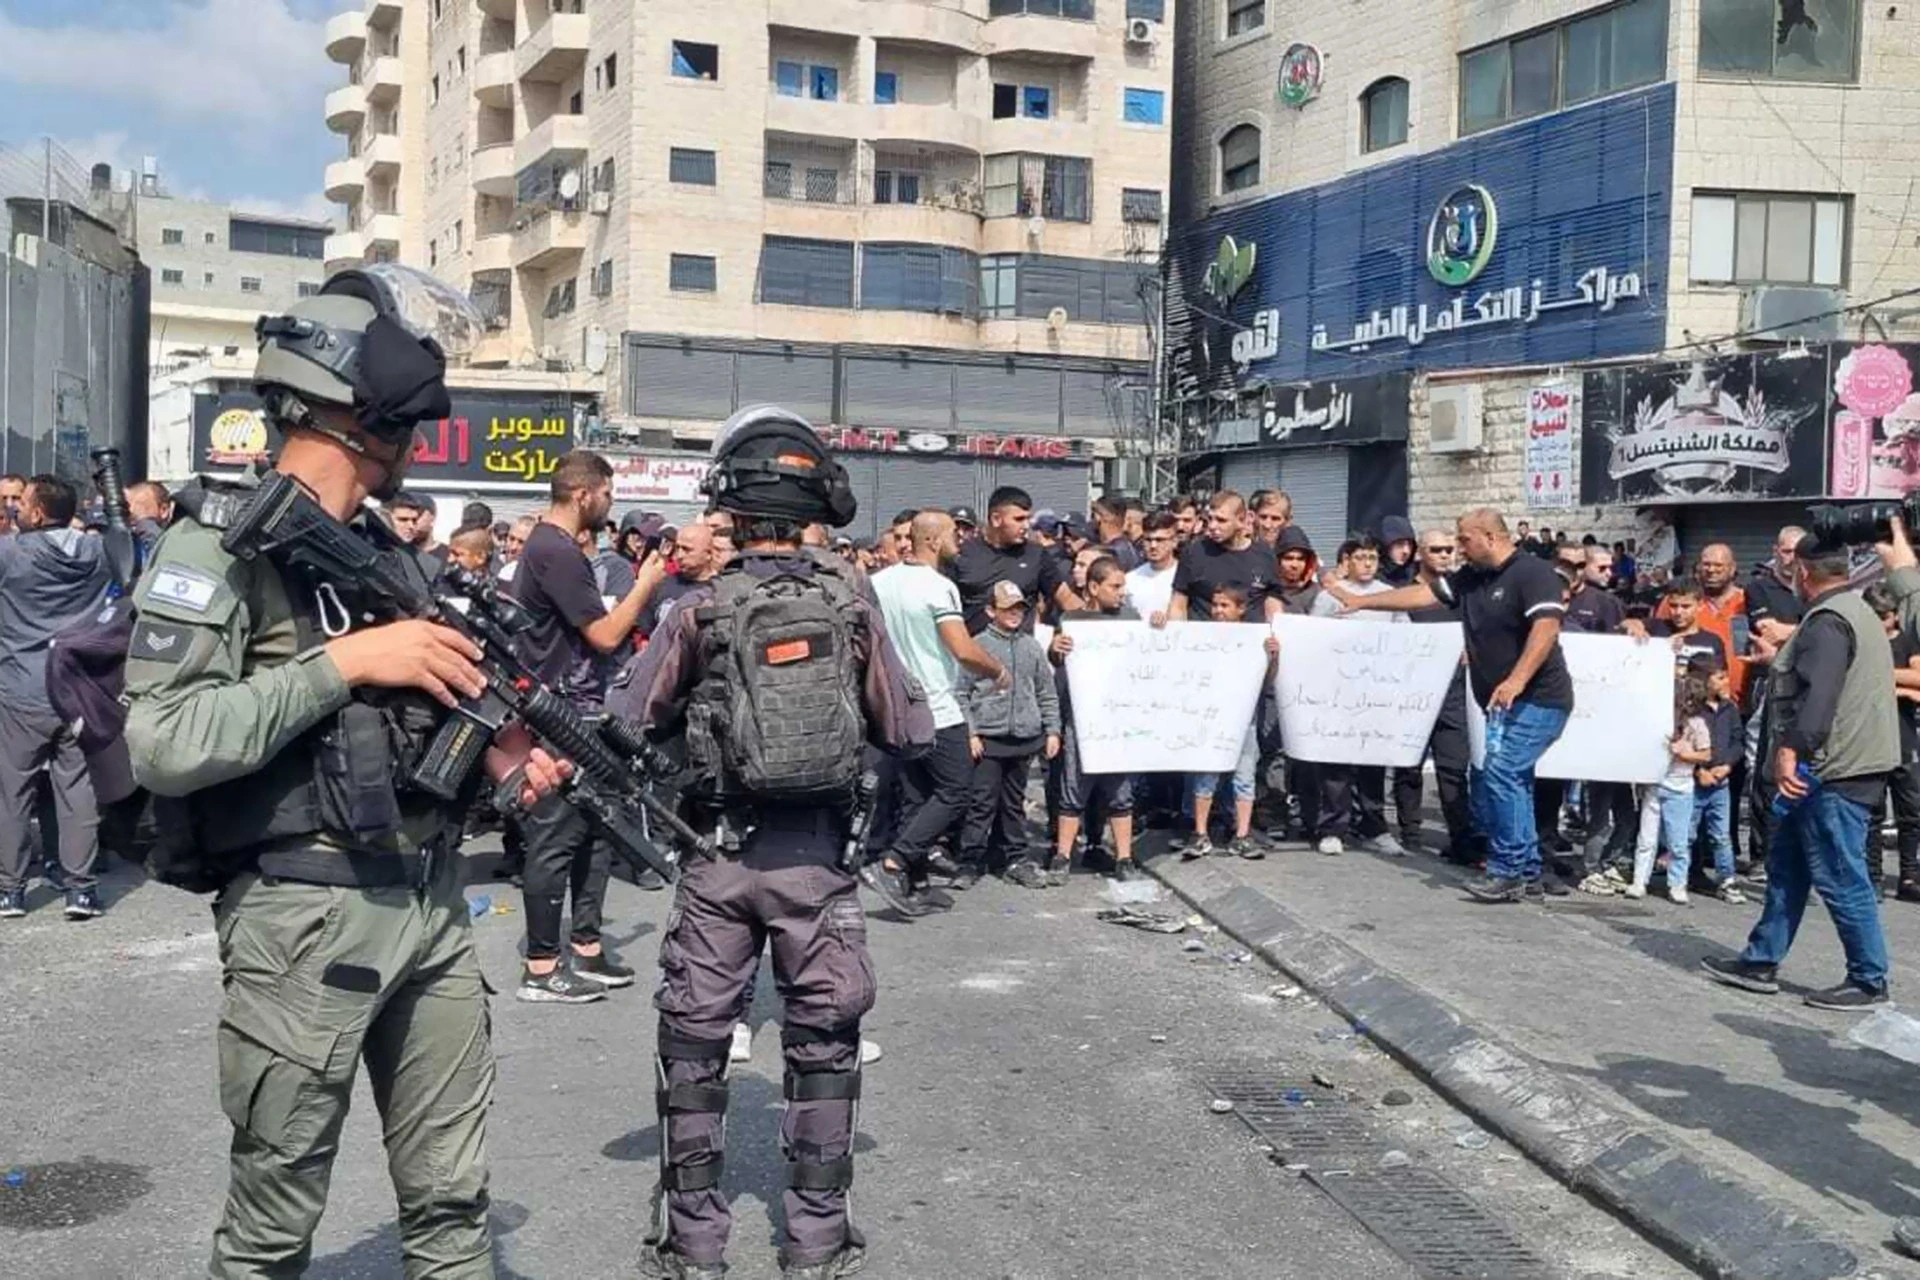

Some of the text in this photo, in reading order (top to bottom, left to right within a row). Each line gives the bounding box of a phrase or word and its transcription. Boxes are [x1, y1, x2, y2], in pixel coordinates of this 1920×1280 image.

[1311, 267, 1640, 352] مراكز التكامل الطبية
[1263, 382, 1351, 441] الأسطورة
[1531, 389, 1569, 412] محلات
[486, 415, 566, 442] سوبر
[1529, 409, 1567, 440] للبيع
[1626, 433, 1718, 463] الشنيتسل
[1721, 432, 1780, 454] مملكة
